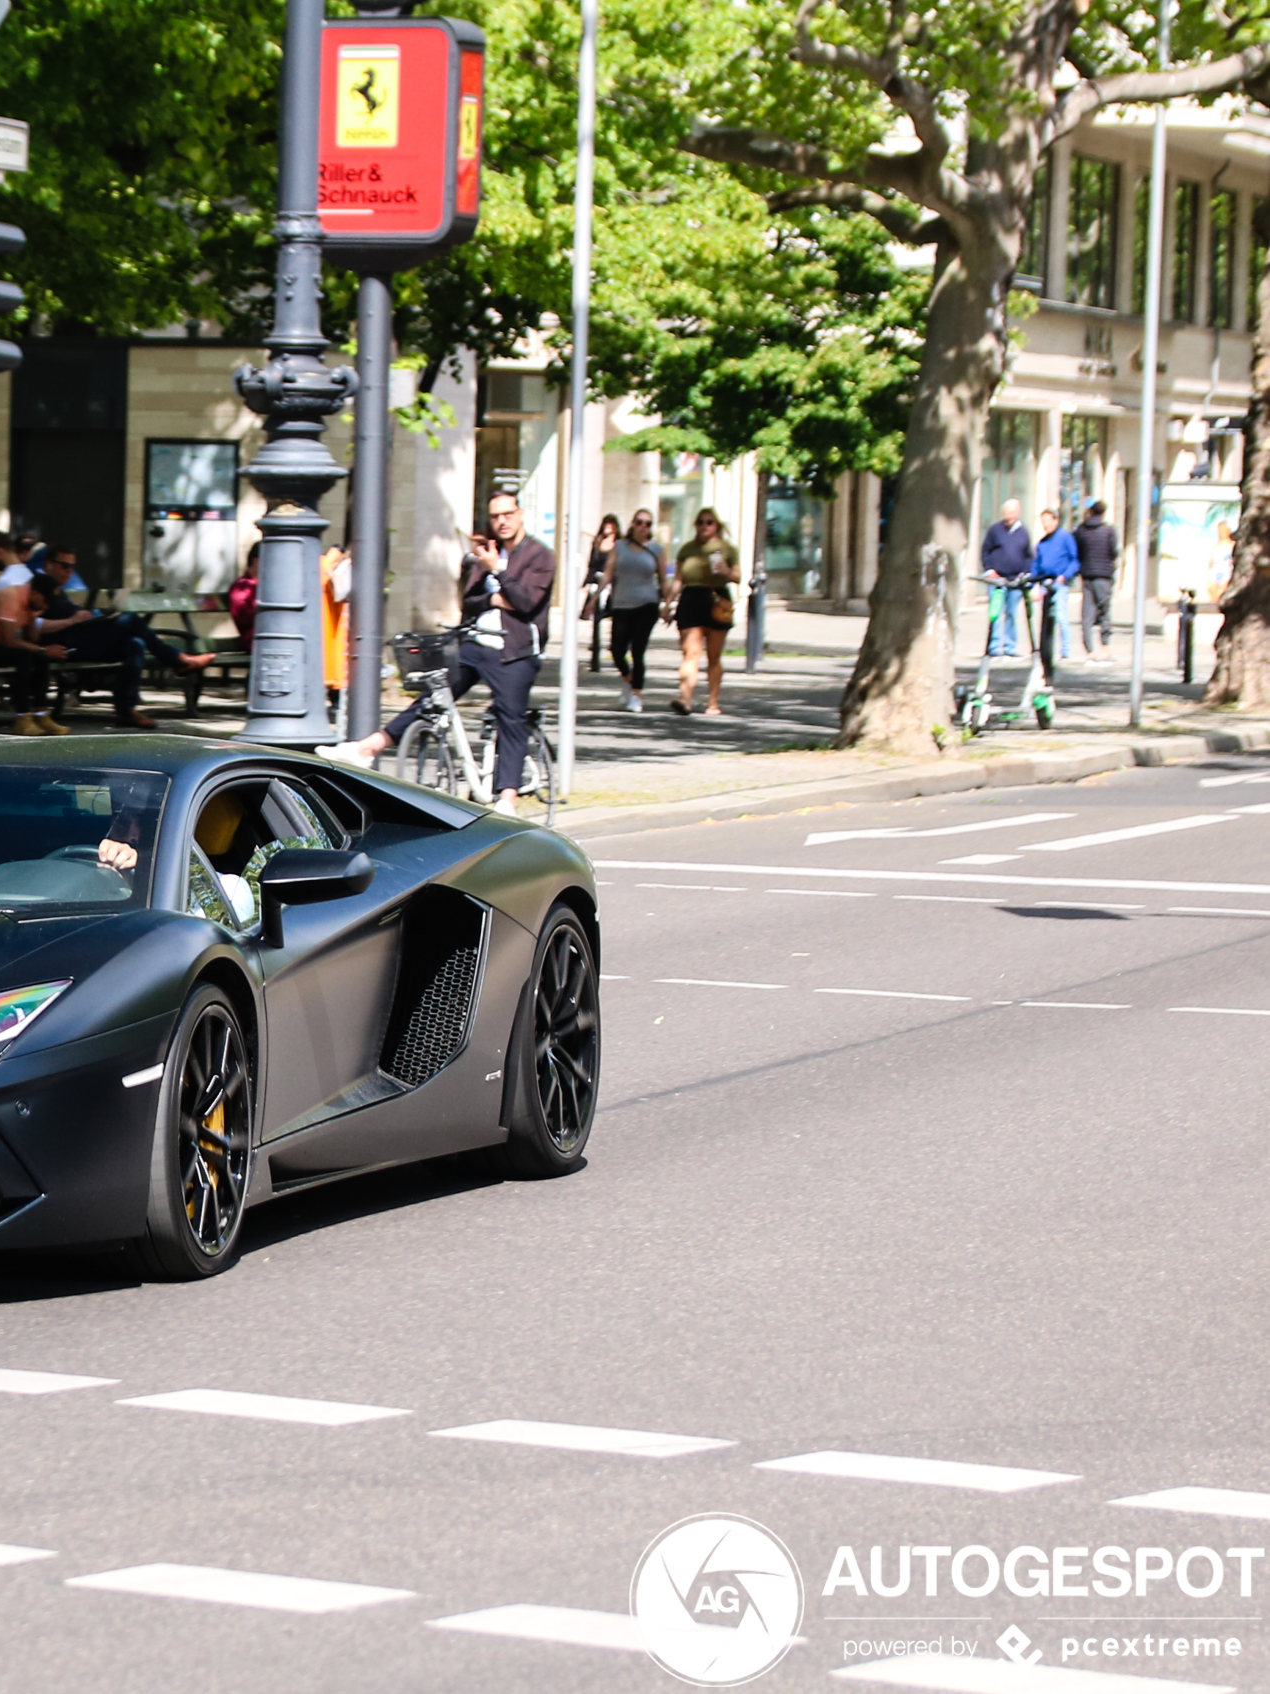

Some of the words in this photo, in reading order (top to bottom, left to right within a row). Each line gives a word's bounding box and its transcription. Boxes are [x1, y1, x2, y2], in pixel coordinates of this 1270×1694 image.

[318, 163, 365, 182] Riller
[368, 163, 382, 182] &
[318, 185, 418, 203] Schnauck
